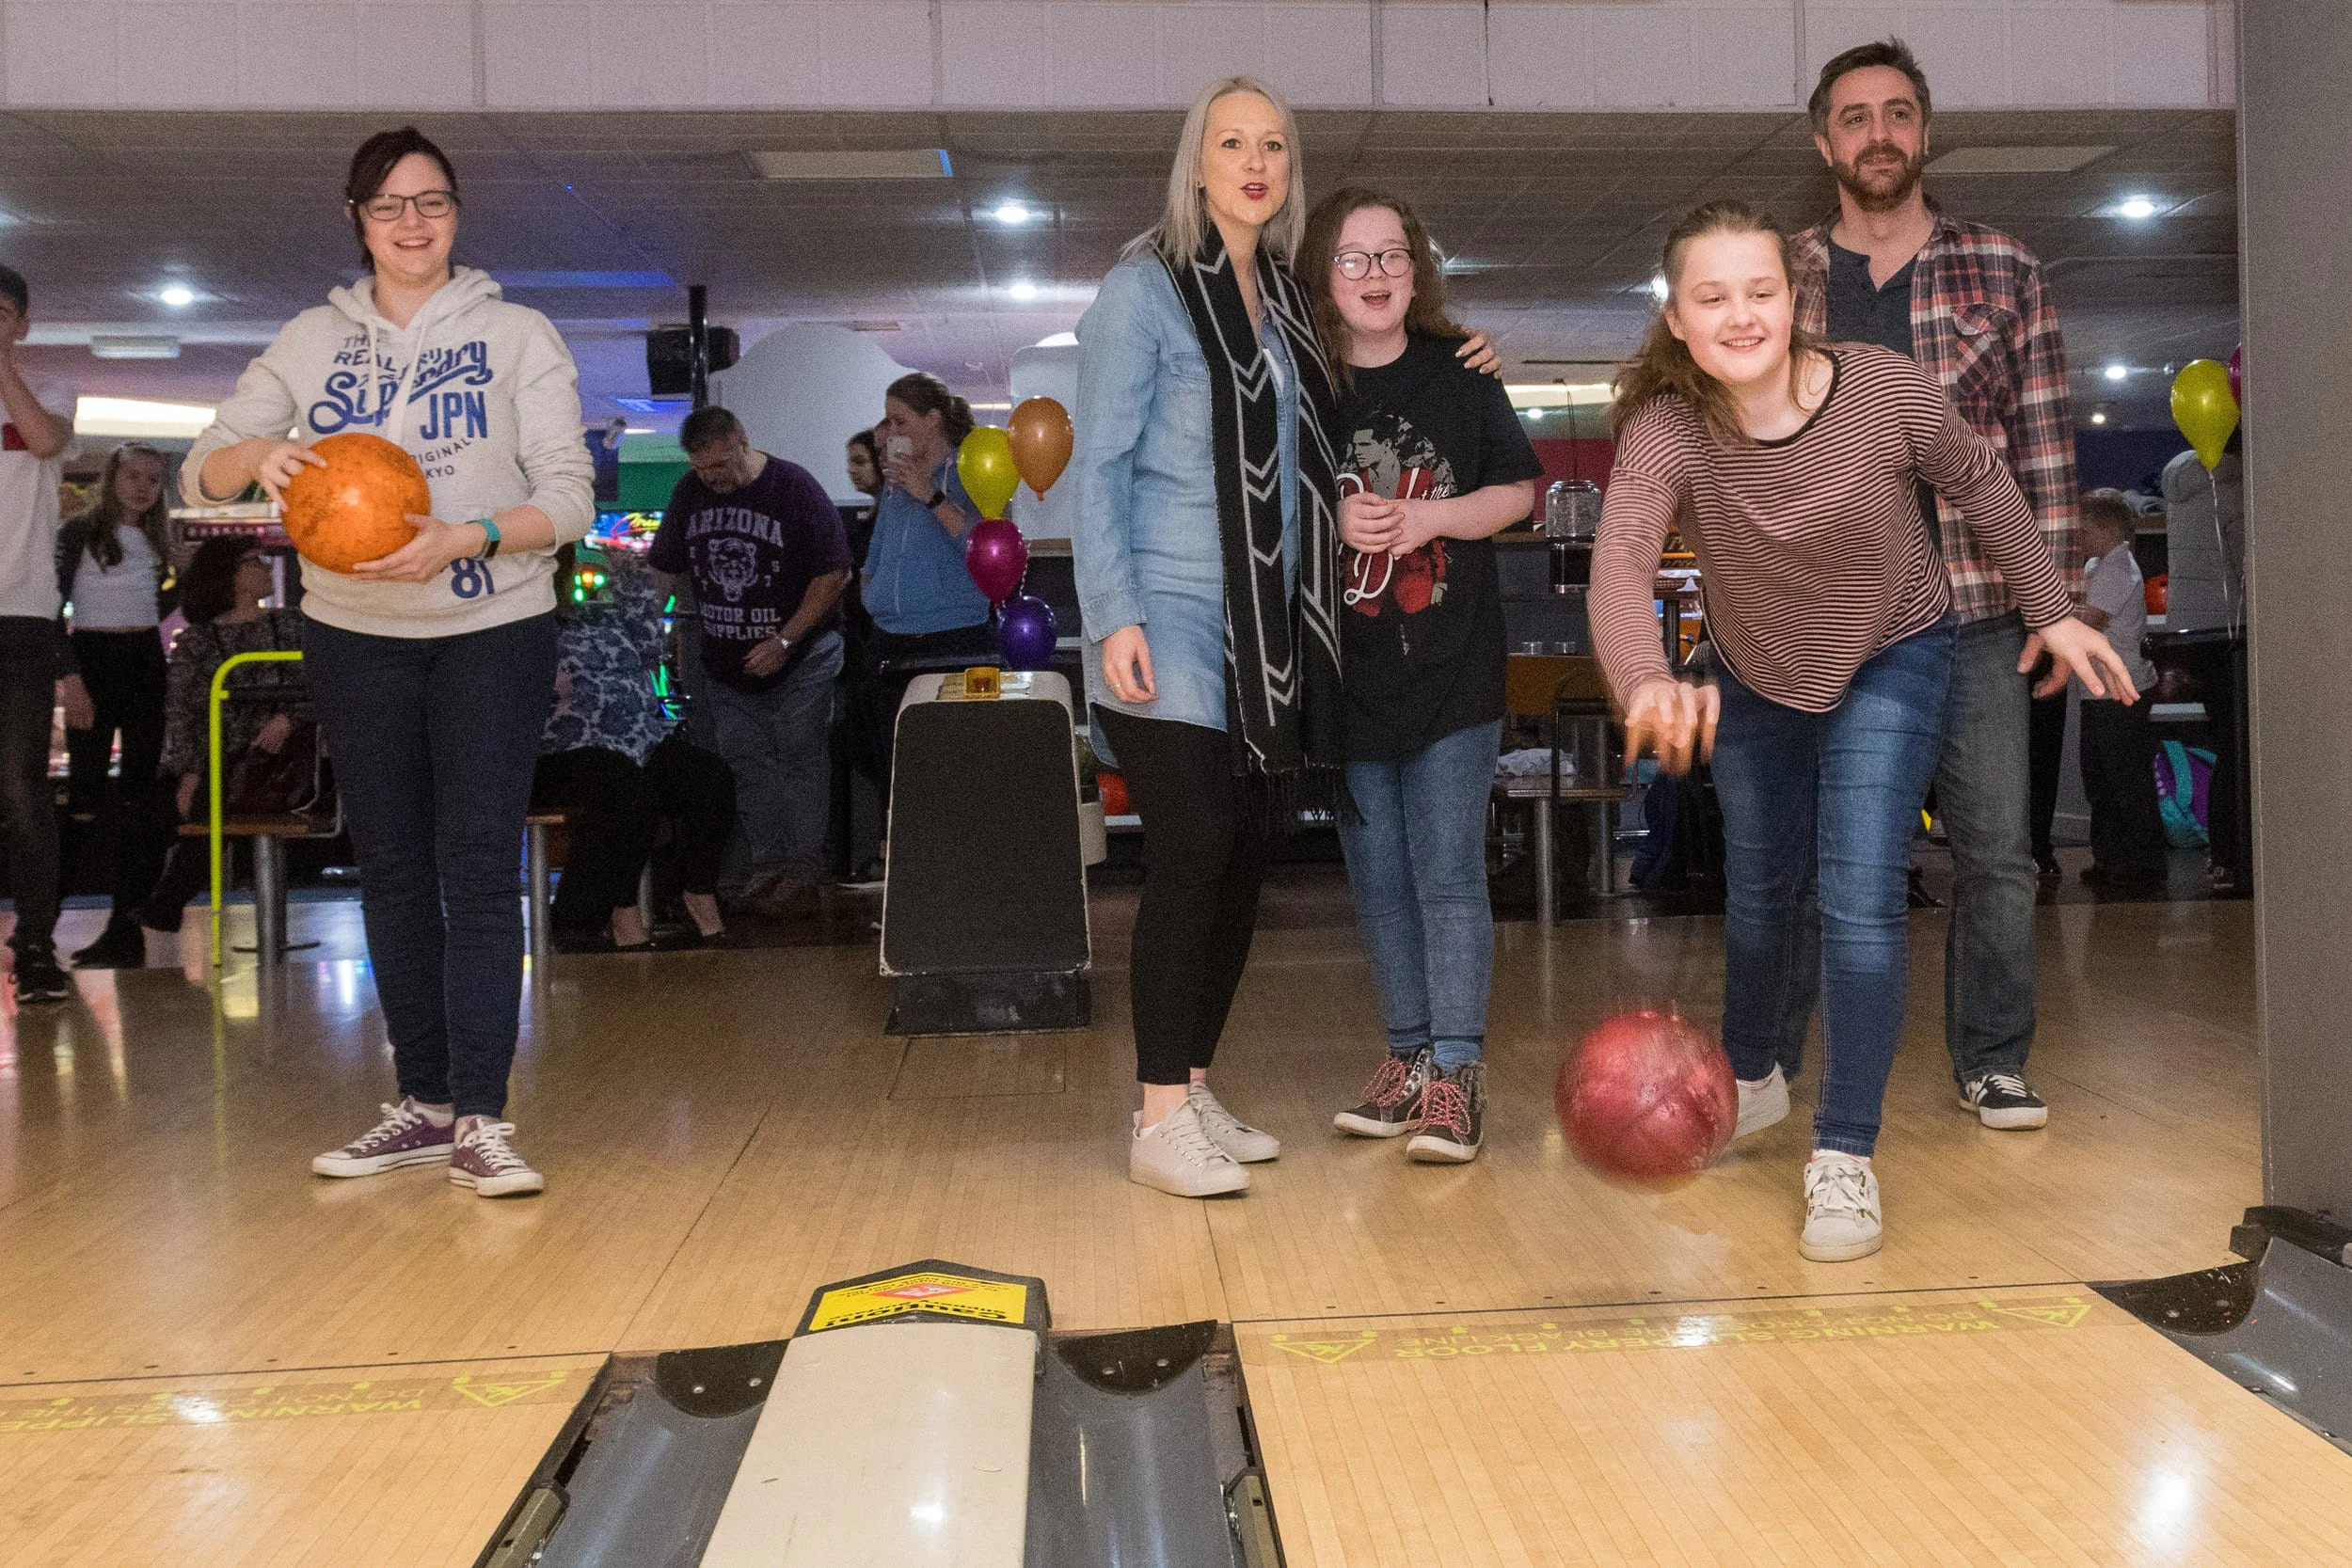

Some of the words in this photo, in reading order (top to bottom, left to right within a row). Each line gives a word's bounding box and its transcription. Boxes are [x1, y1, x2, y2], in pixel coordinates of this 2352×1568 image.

[344, 334, 379, 349] TH
[309, 341, 493, 434] Sprdry
[420, 390, 487, 440] JPN
[411, 437, 471, 464] IGINAL
[425, 465, 454, 479] KYO
[685, 506, 784, 548] ARIZONA
[451, 557, 495, 599] 81
[751, 608, 781, 623] OIL
[1485, 1329, 1610, 1341] BLACK
[1620, 1326, 1670, 1337] HE
[1788, 1320, 2001, 1339] WARNING
[1392, 1340, 1549, 1359] FLOOR
[1397, 1336, 1479, 1347] LINE
[1564, 1331, 1776, 1350] SLIPERY
[223, 1399, 423, 1418] WARNIN
